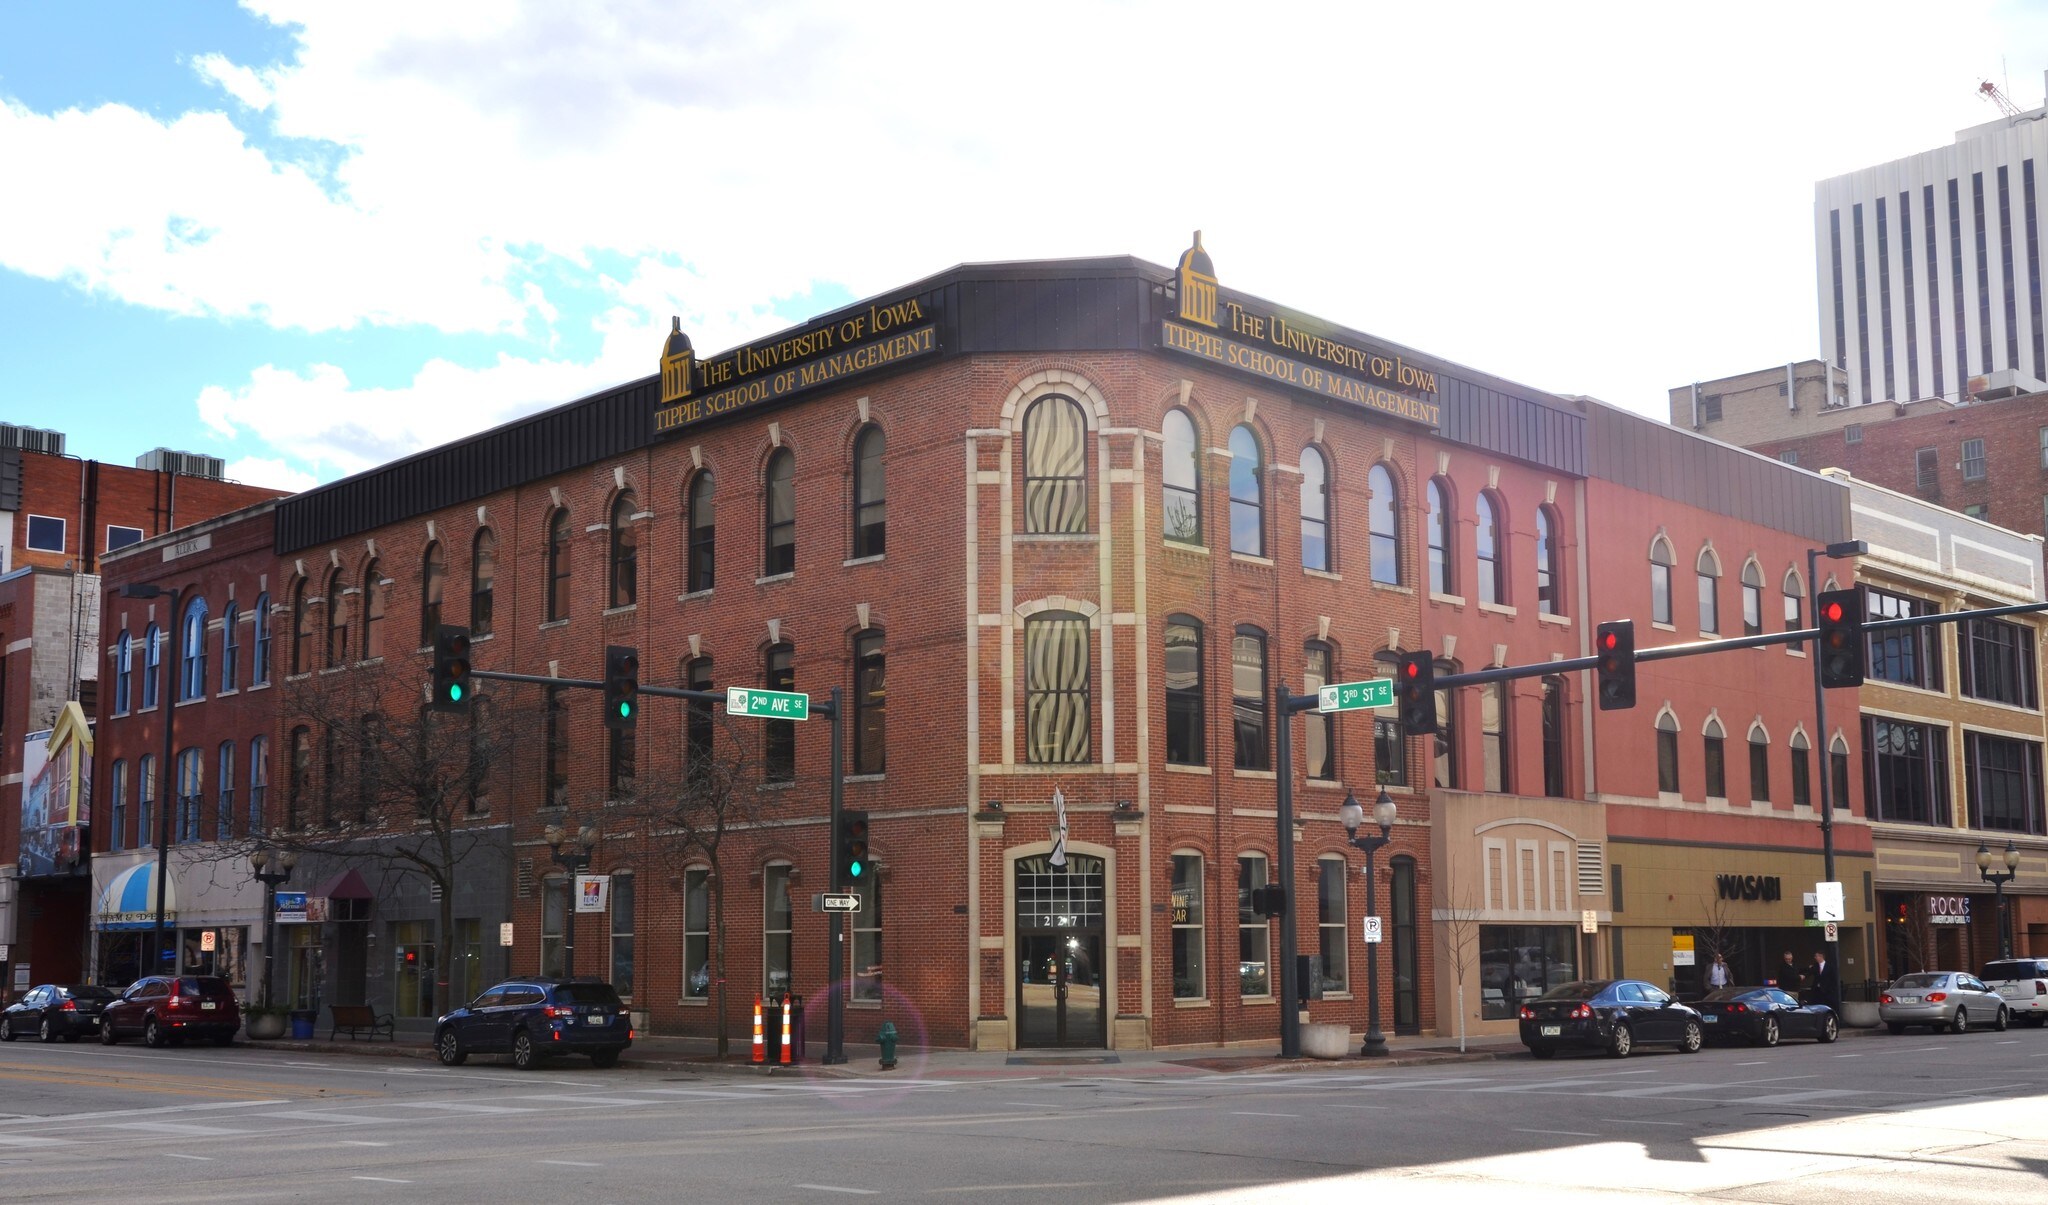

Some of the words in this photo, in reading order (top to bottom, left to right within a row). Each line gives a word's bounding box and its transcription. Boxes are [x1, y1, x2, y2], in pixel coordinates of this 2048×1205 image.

[702, 360, 732, 387] THE
[736, 326, 834, 376] UNIVERSITY
[841, 317, 865, 343] OF
[871, 299, 922, 334] IOWA
[1227, 302, 1265, 340] THE
[1270, 316, 1366, 371] UNIVERSITY
[1371, 357, 1392, 380] OF
[1397, 356, 1438, 394] IOWA
[655, 399, 702, 430] TIPPIE
[705, 380, 770, 416] SCHOOL
[774, 371, 796, 394] OF
[800, 328, 933, 387] MANAGEMENT
[1164, 322, 1223, 360] TIPPIE
[1228, 344, 1297, 382] SCHOOL
[1302, 367, 1323, 390] OF
[1328, 375, 1439, 425] MANAGEMENT
[751, 696, 768, 710] 2ND
[771, 698, 790, 712] AVE
[794, 700, 803, 709] SE
[1342, 688, 1358, 704] 3RD
[1362, 687, 1375, 702] ST
[1378, 686, 1388, 696] SE
[1717, 874, 1781, 901] WASABI
[826, 899, 837, 907] ONE
[1171, 894, 1189, 908] WINE
[1930, 896, 1965, 915] ROCK
